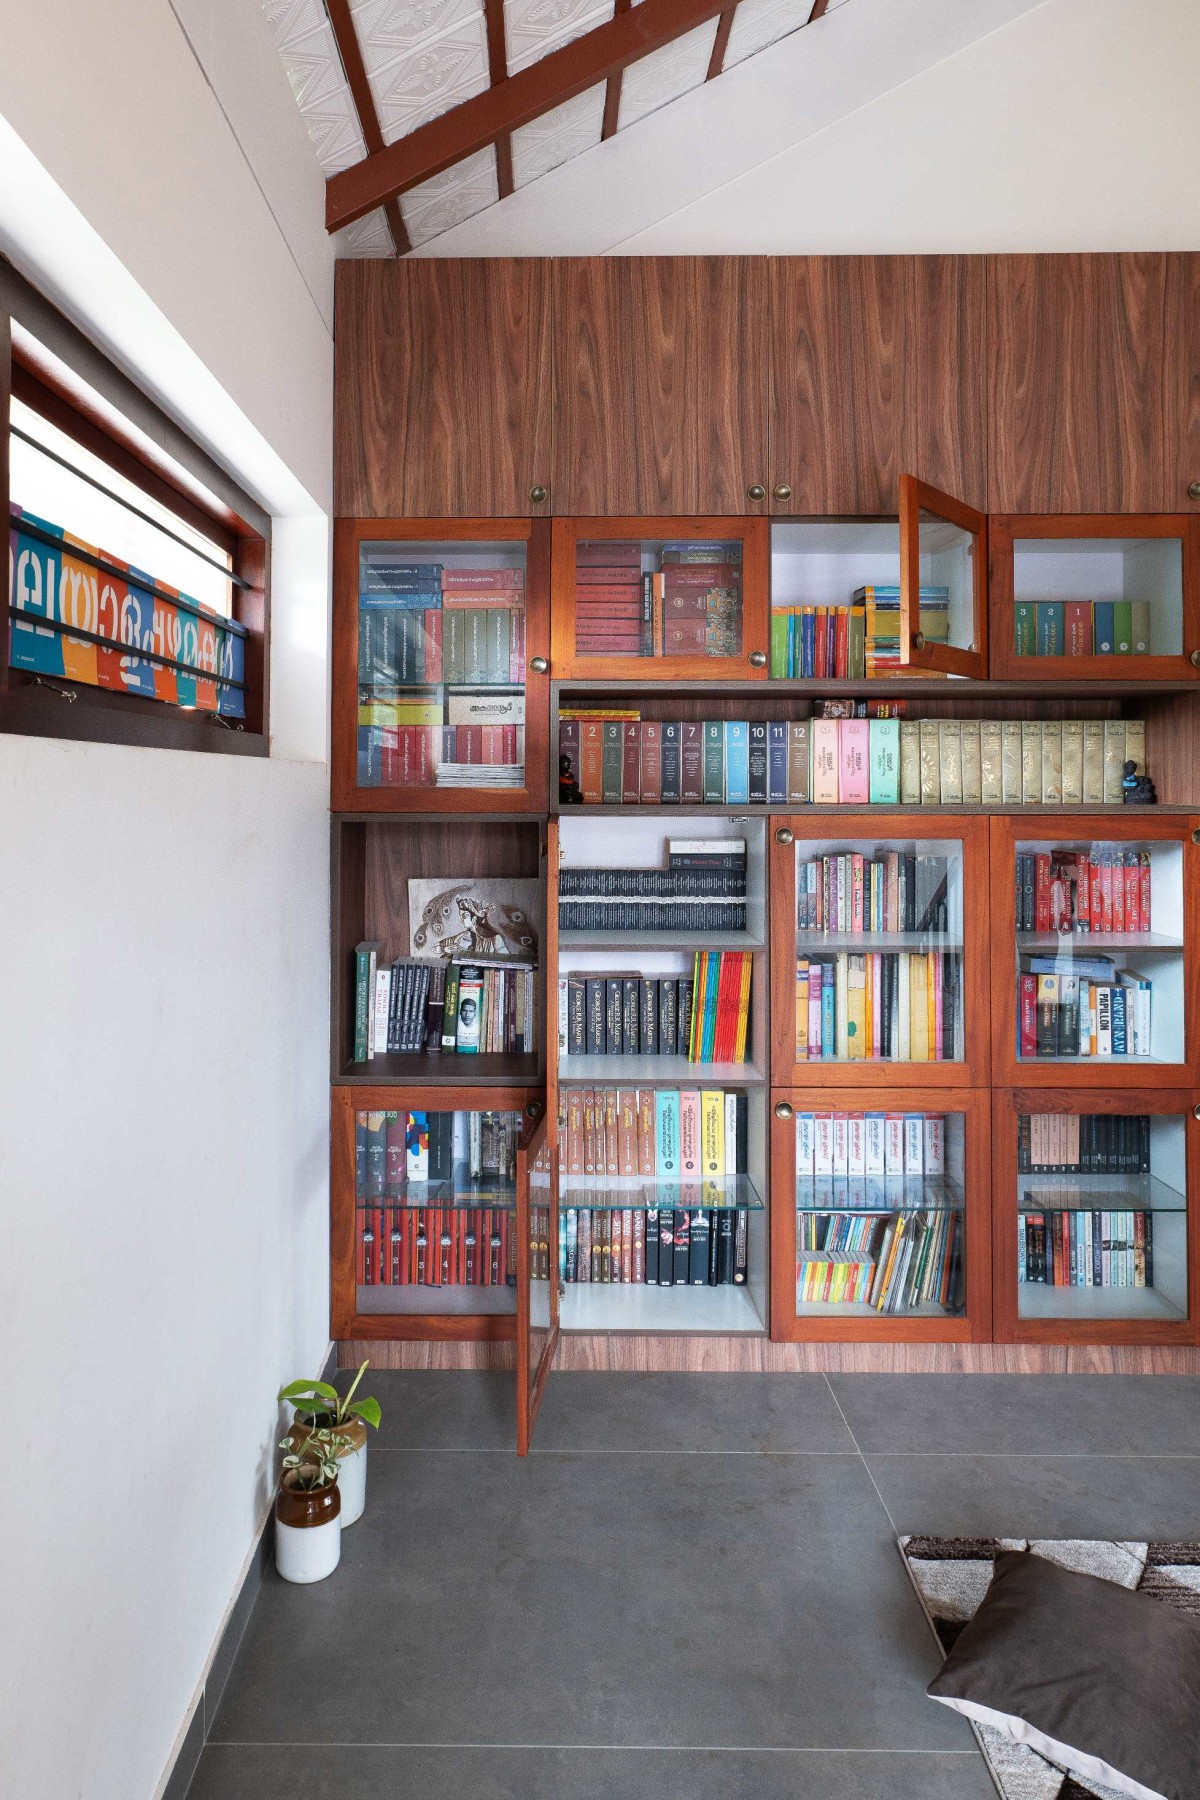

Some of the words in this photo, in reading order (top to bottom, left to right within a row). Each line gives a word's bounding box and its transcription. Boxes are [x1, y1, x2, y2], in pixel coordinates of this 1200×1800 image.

[567, 727, 572, 736] 1
[588, 727, 596, 737] 2
[609, 727, 616, 737] 3
[628, 727, 636, 736] 4
[647, 728, 654, 737] 5
[667, 727, 674, 737] 6
[689, 727, 695, 737] 7
[710, 727, 717, 737] 8
[733, 727, 740, 737] 9
[752, 727, 764, 737] 10
[774, 728, 782, 737] 11
[793, 728, 805, 737] 12
[1099, 993, 1109, 1030] PAPILLON
[1113, 996, 1125, 1025] RAND
[1115, 1031, 1125, 1052] AYN
